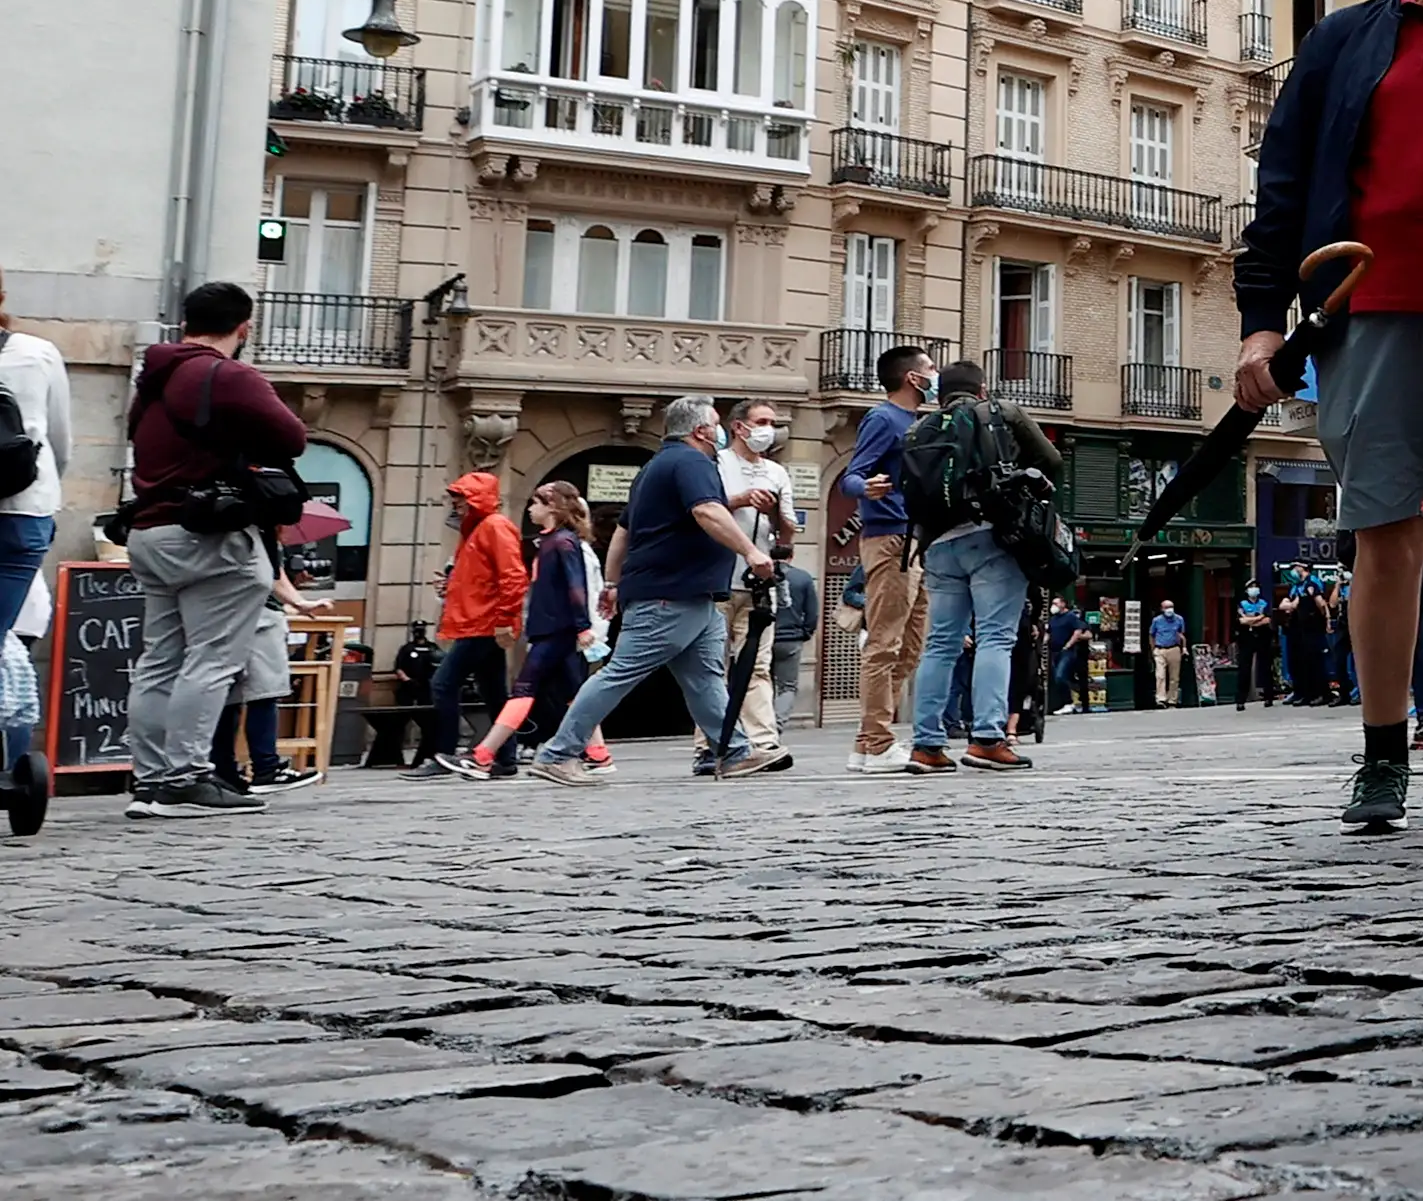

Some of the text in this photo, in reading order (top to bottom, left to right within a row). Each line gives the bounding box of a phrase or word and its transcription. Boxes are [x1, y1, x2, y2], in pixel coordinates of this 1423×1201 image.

[829, 555, 860, 567] CALZ
[75, 572, 109, 598] The
[79, 616, 141, 652] CAF
